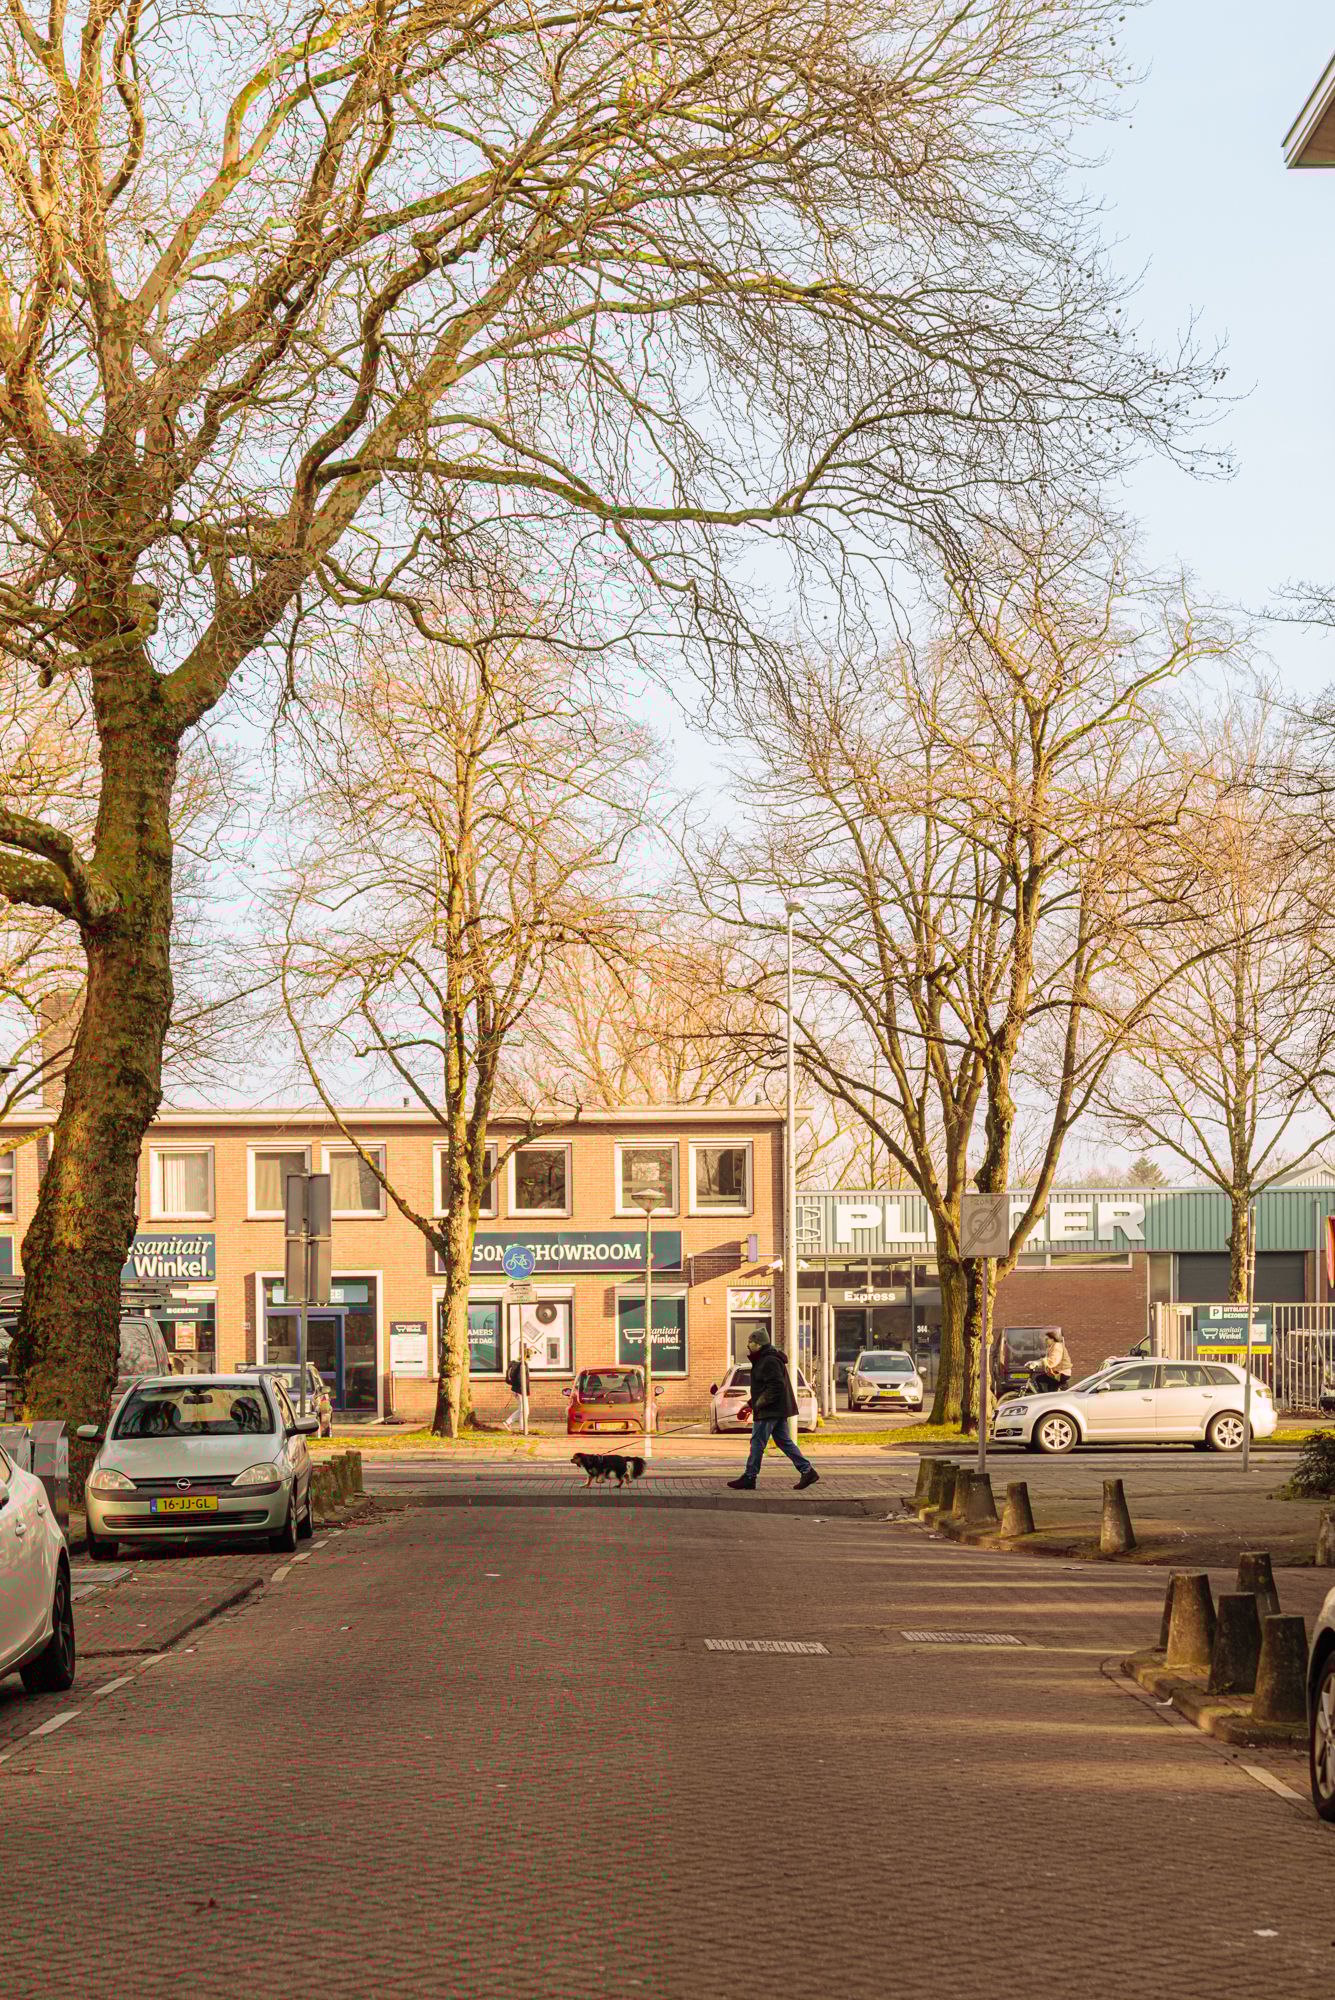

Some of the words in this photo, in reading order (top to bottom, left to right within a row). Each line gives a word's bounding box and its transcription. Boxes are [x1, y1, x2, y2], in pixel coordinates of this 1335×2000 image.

[133, 1236, 213, 1255] sanitair
[732, 1291, 771, 1309] 342
[844, 1290, 896, 1303] Express
[651, 1326, 681, 1335] anitair
[164, 1498, 211, 1510] 16-JJ-GL
